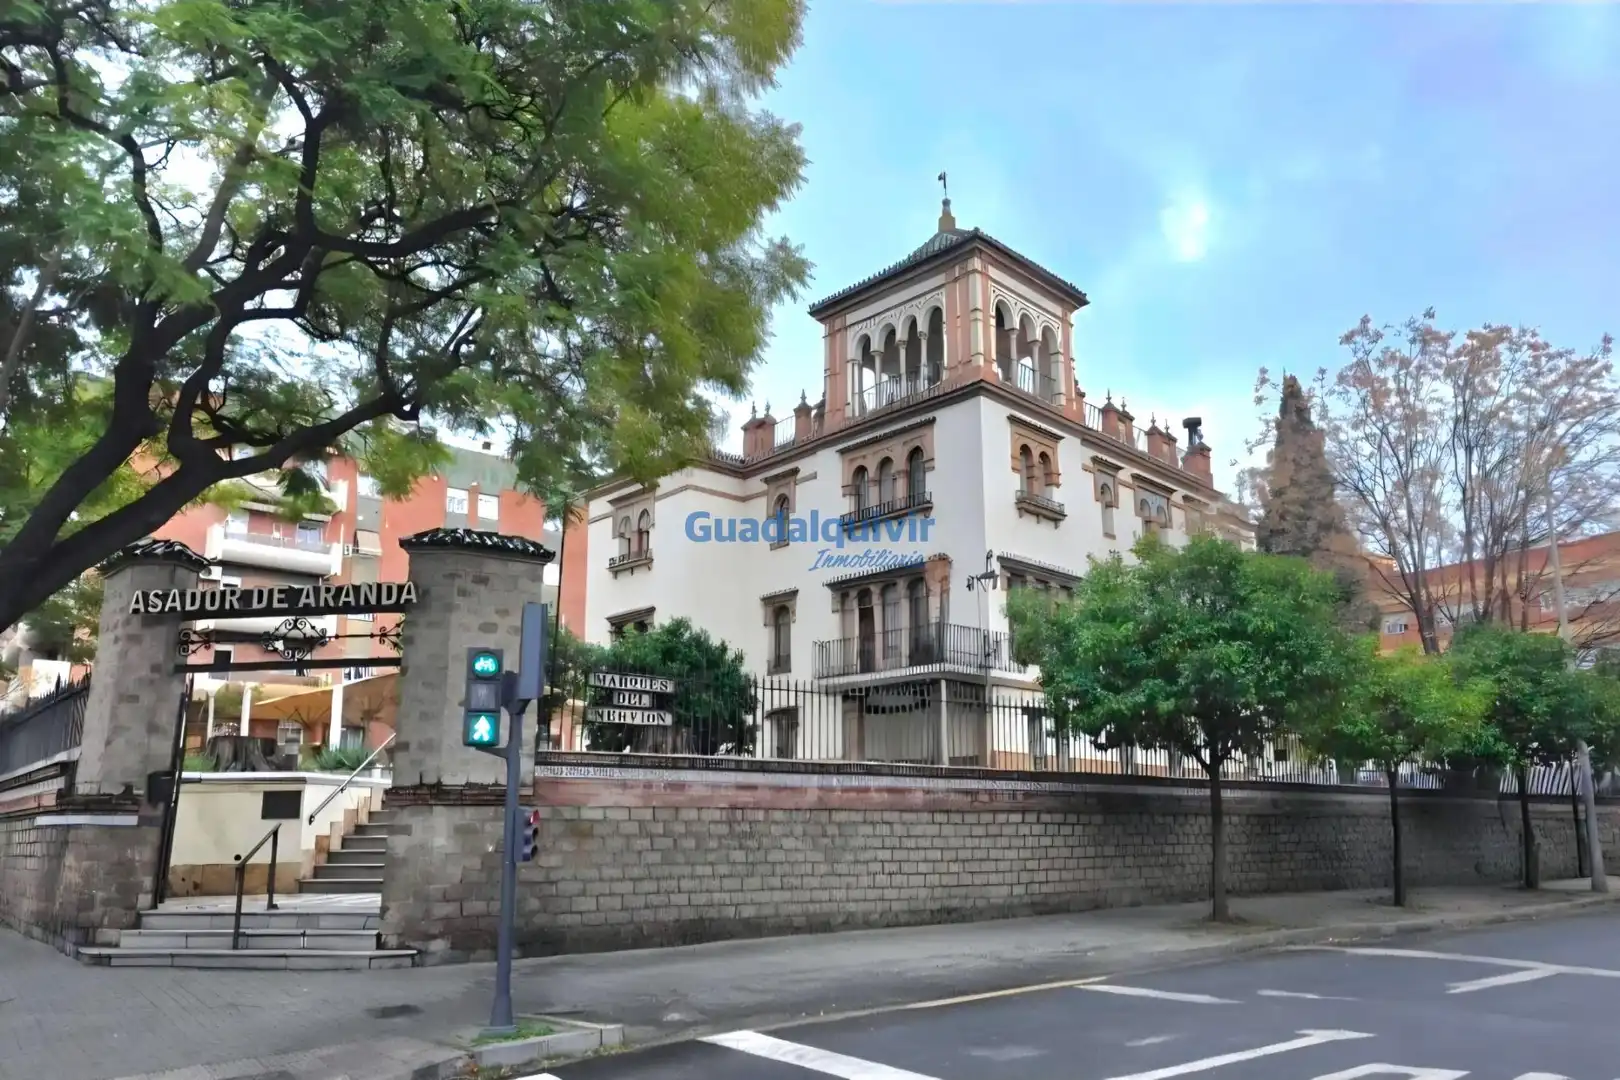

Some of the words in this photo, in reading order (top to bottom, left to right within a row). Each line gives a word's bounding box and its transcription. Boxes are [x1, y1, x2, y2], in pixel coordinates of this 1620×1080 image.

[129, 588, 241, 614] ASADOR
[252, 587, 289, 609] DE
[299, 581, 417, 608] ARANDA
